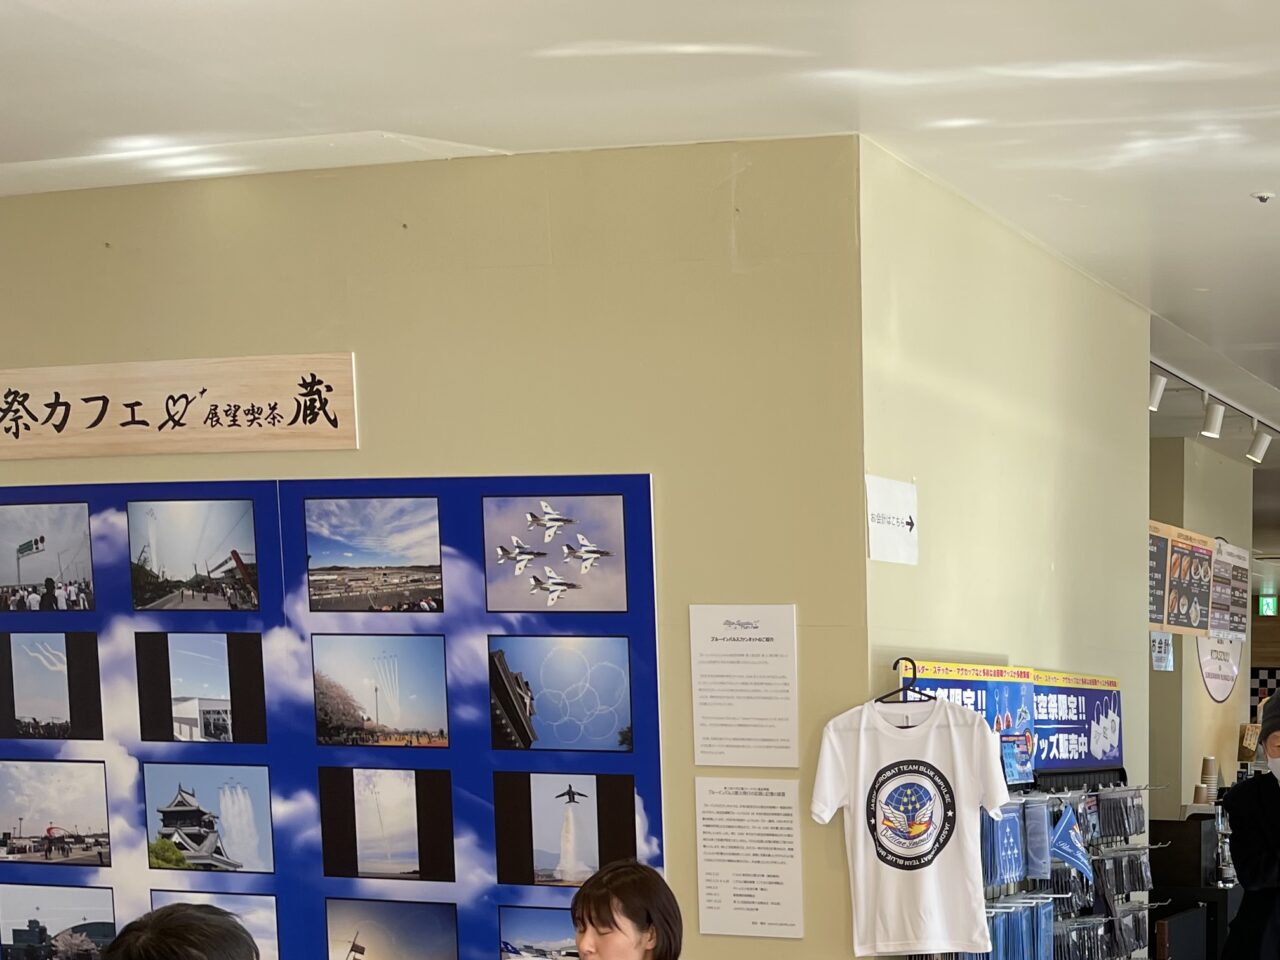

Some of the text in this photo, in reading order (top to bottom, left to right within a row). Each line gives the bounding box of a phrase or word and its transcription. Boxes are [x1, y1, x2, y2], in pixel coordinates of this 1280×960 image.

[203, 402, 285, 428] 展望喫茶
[287, 372, 339, 429] 蔵
[919, 765, 935, 778] BLUE
